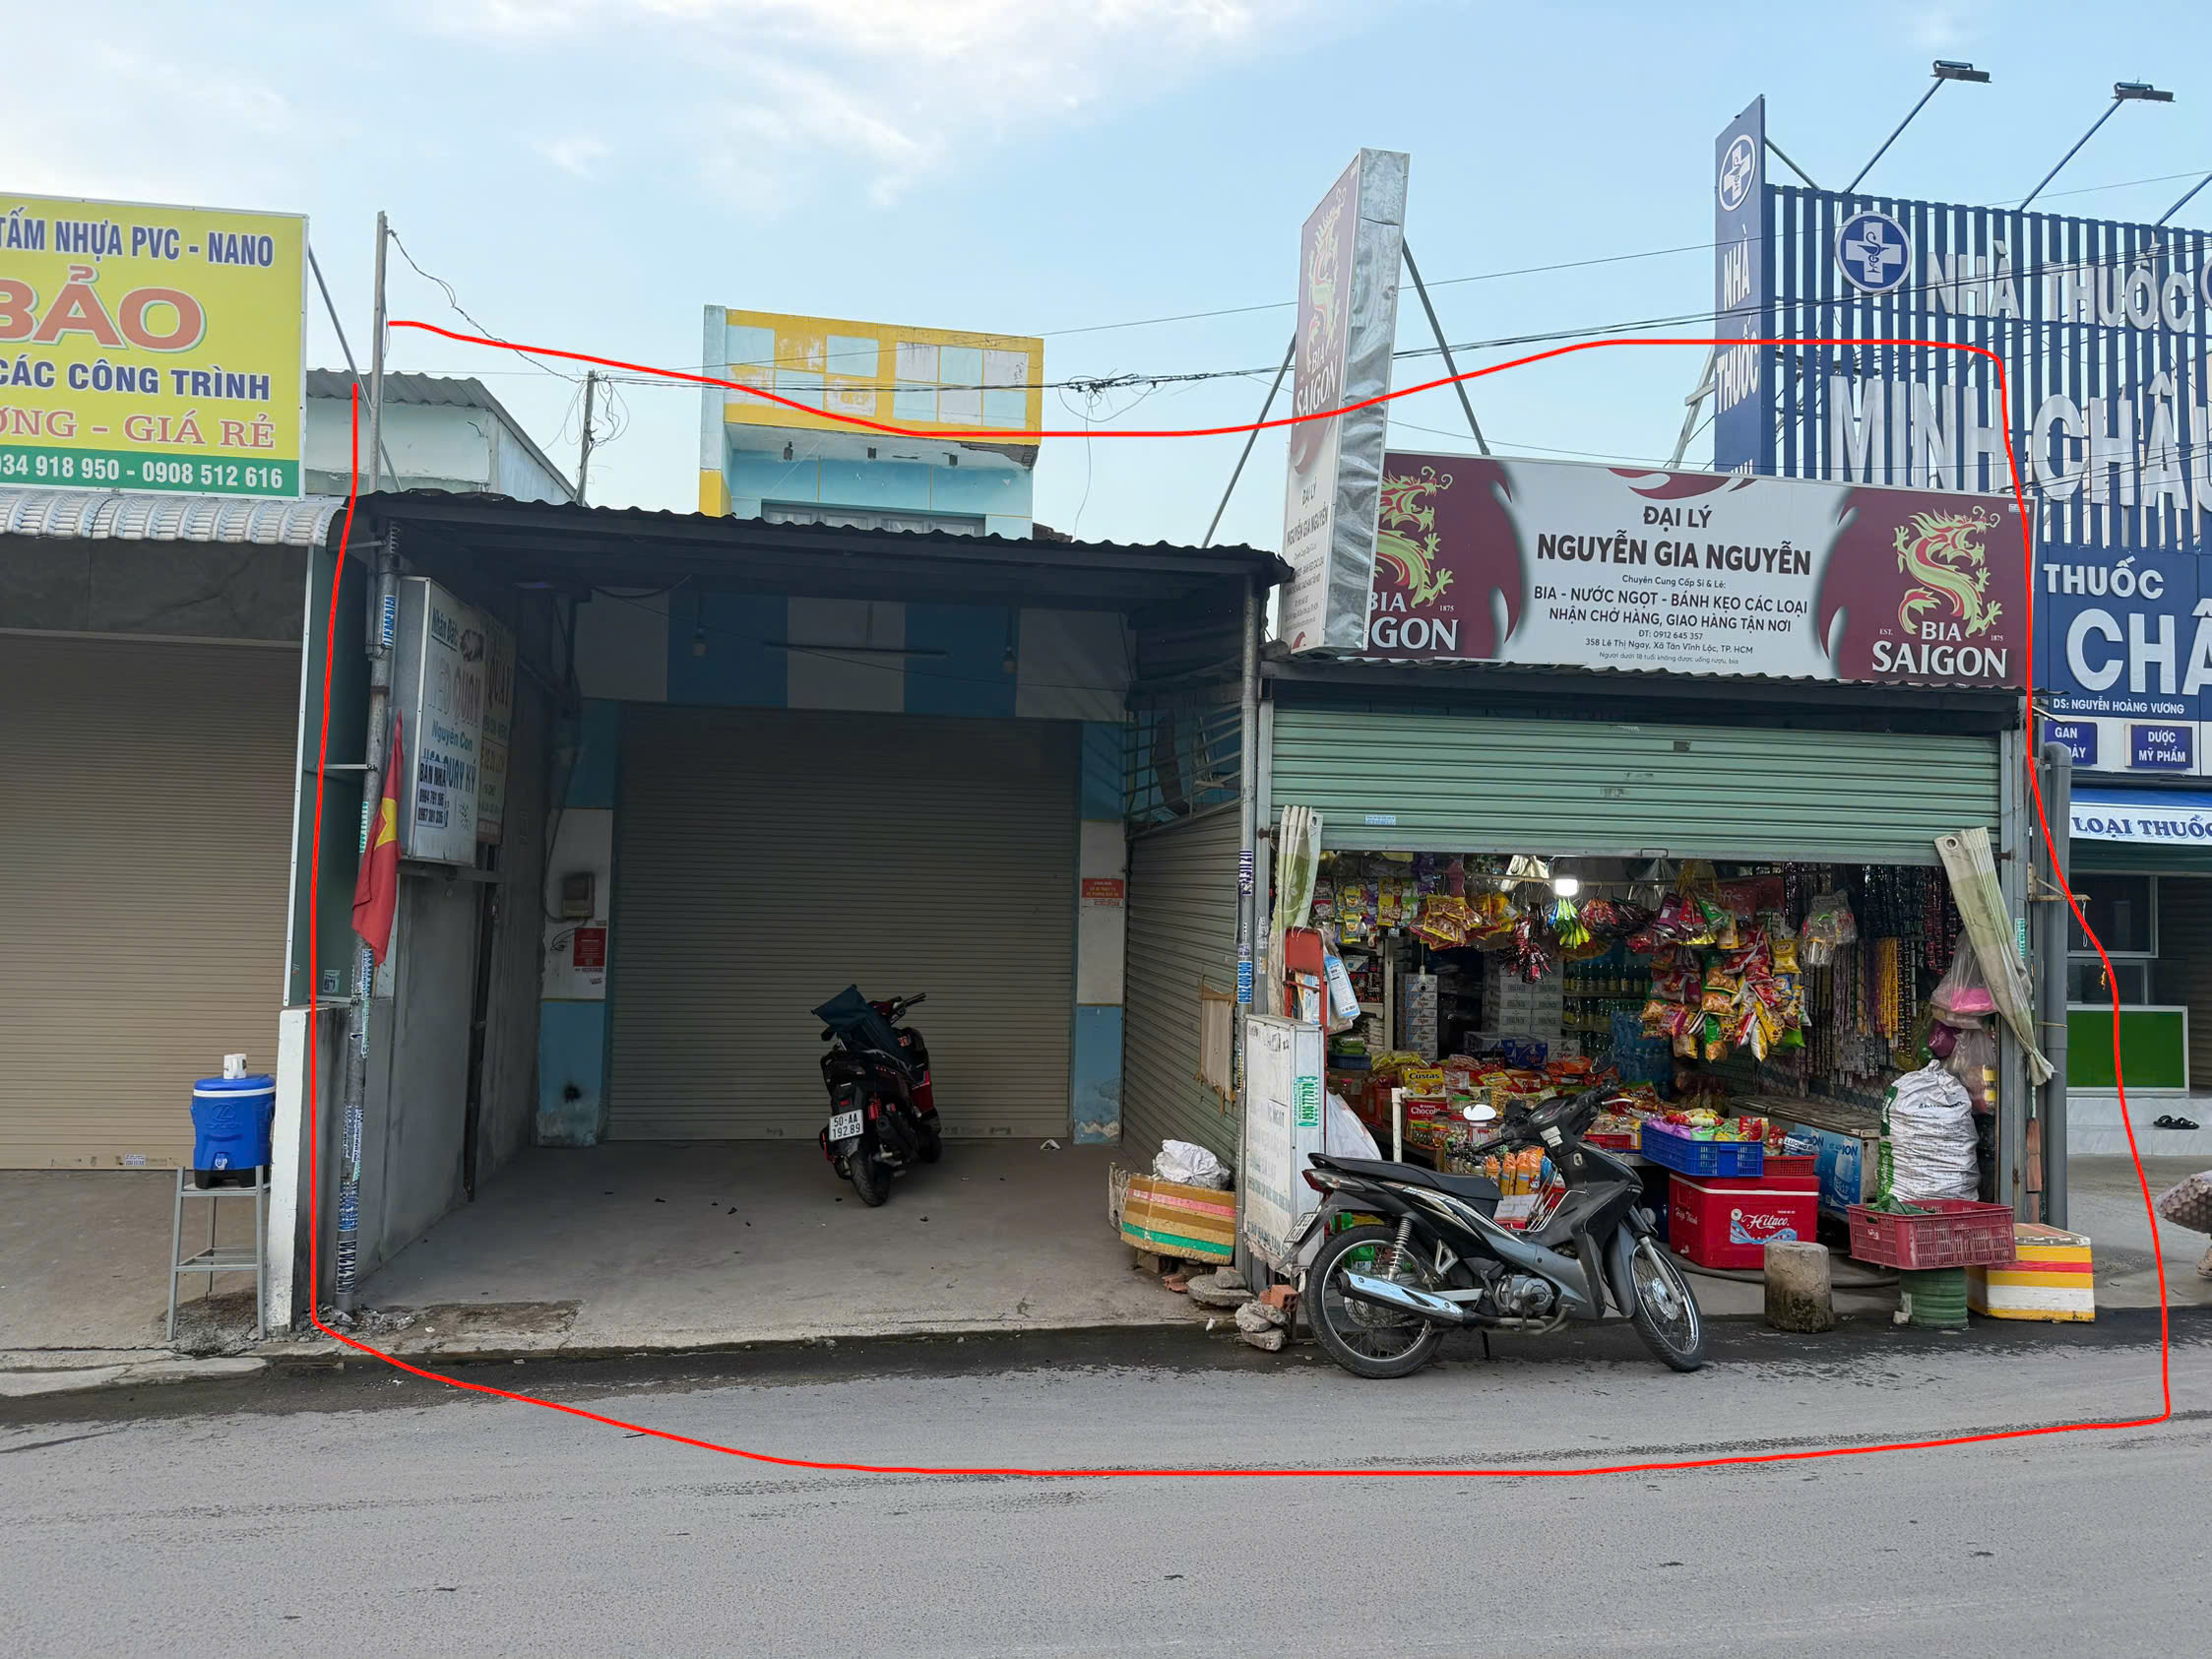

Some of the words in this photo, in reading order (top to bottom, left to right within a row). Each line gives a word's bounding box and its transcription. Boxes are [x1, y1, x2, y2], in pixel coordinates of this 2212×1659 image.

[55, 220, 123, 262] NHỰA
[132, 225, 180, 260] PVC
[208, 231, 274, 267] NANO
[1724, 223, 1751, 311] NHÀ
[1927, 239, 2021, 319] NHÀ
[2042, 242, 2193, 333] THUỐC
[68, 358, 159, 394] CÔNG
[170, 365, 270, 401] TRÌNH
[125, 410, 206, 445] GIÁ
[220, 414, 275, 449] RẺ
[1829, 375, 2007, 493] MINH
[0, 454, 29, 476] 34
[35, 456, 75, 478] 918
[82, 458, 119, 480] 950
[142, 461, 193, 483] 0908
[200, 464, 238, 486] 512
[245, 466, 283, 488] 616
[1643, 505, 1681, 533] ĐẠI
[1687, 504, 1713, 529] LÝ
[1537, 529, 1648, 566] NGUYỄN
[1654, 541, 1699, 568] GIA
[1706, 541, 1811, 576] NGUYỄN
[1655, 576, 1676, 587] Cung
[2043, 555, 2165, 601] THUỐC
[1534, 586, 1557, 601] BIA
[1570, 585, 1614, 604] NƯỚC
[1618, 590, 1659, 609] NGỌT
[1671, 591, 1710, 608] BÁNH
[1713, 595, 1741, 613] KẸO
[1745, 595, 1773, 611] CÁC
[1777, 599, 1808, 618] LOẠI
[1549, 605, 1587, 624] NHẬN
[1590, 606, 1620, 623] CHỞ
[1623, 610, 1663, 627] HÀNG,
[1666, 613, 1698, 627] GIAO
[1701, 612, 1738, 630] HÀNG
[1740, 615, 1765, 634] TẬN
[1768, 618, 1792, 632] NƠI
[1922, 620, 1962, 642] BIA
[1638, 629, 1652, 638] ĐT:
[1653, 630, 1672, 639] 0912
[1673, 631, 1688, 640] 645
[1682, 642, 1701, 652] Vĩnh
[1734, 645, 1753, 655] HCM
[1871, 640, 2008, 678] SAIGON
[2053, 697, 2069, 710] DS:
[2071, 695, 2110, 711] NGUYỄN
[2112, 698, 2148, 713] HOÀNG
[2150, 702, 2185, 715] VƯƠNG
[2054, 727, 2078, 739] GAN
[2147, 730, 2177, 746] DƯỢC
[2138, 747, 2154, 762] MỸ
[2156, 745, 2186, 763] PHẨM
[2071, 816, 2134, 839] LOẠI
[1237, 961, 1251, 975] 900
[1237, 975, 1251, 988] 400
[832, 1122, 861, 1139] 192.89
[1740, 1214, 1789, 1230] Hitaco
